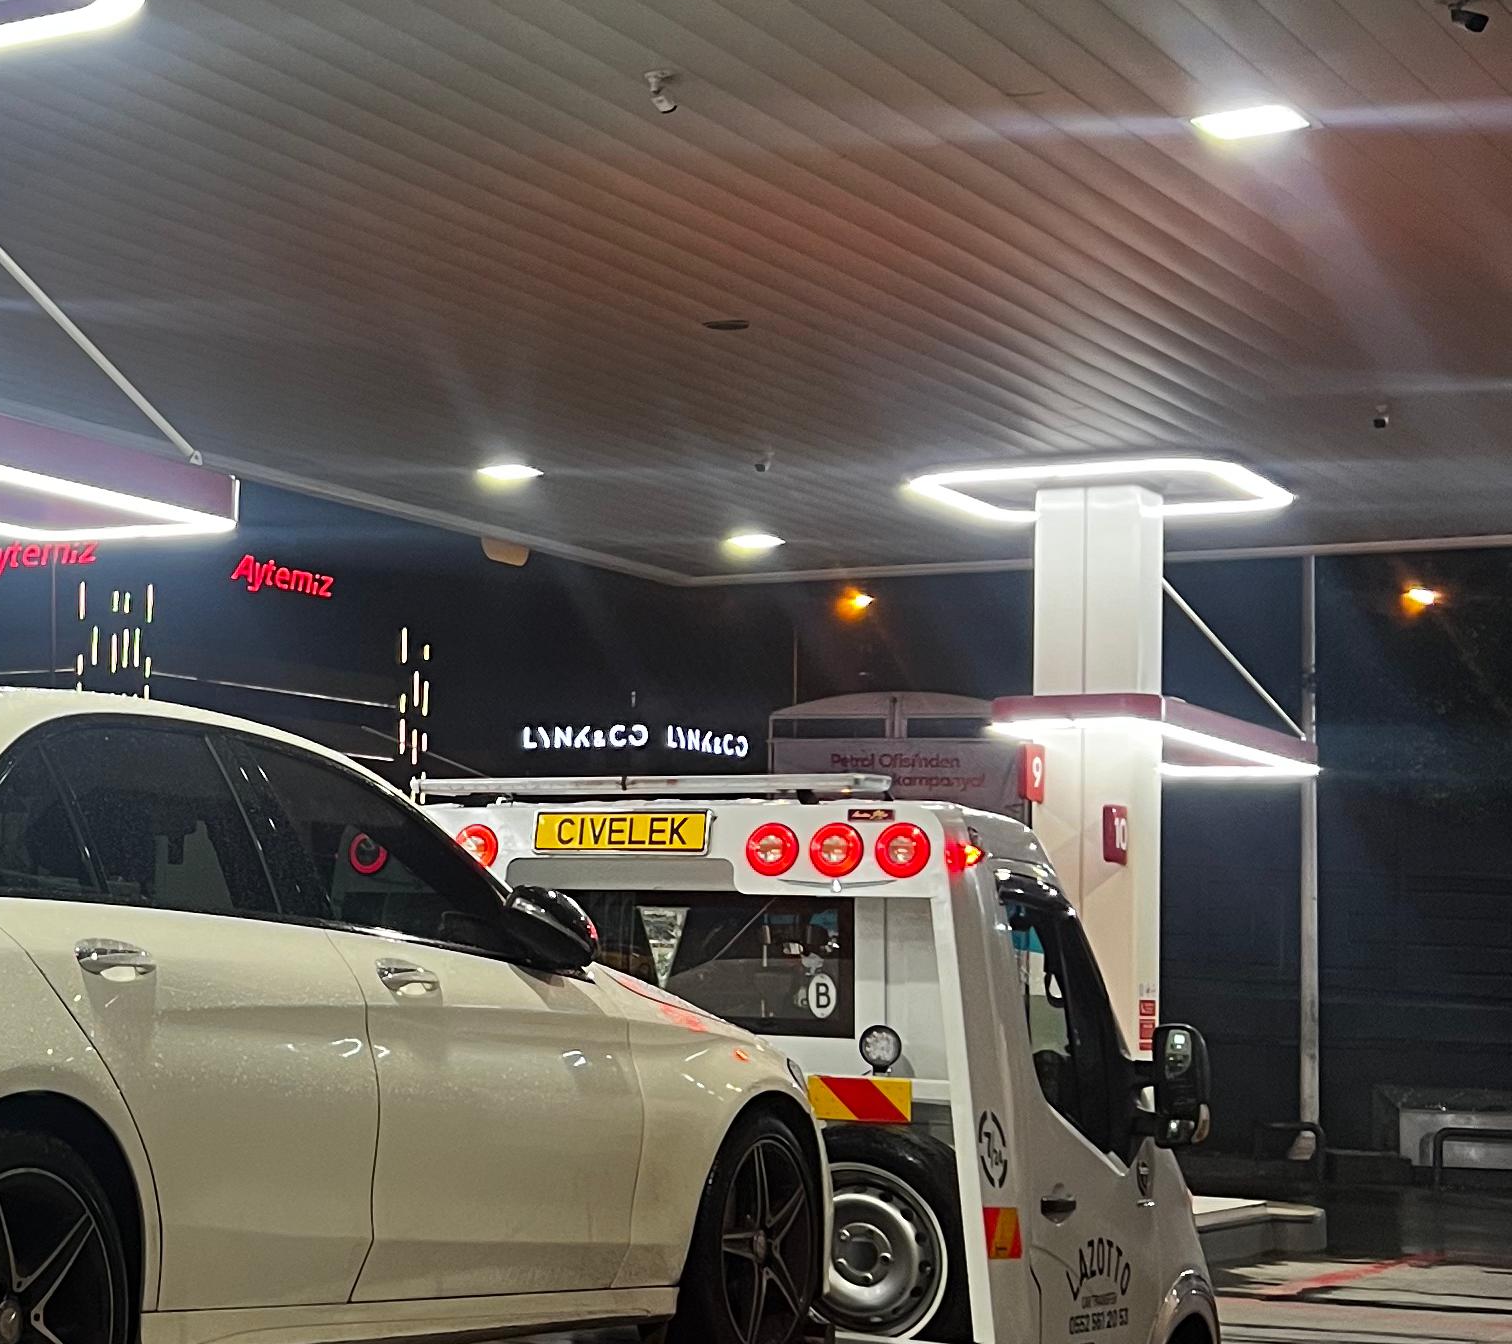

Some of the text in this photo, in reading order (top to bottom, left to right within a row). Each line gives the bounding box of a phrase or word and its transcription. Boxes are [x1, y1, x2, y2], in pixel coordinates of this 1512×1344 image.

[230, 554, 334, 598] Aytemiz
[1031, 756, 1043, 788] 9
[557, 817, 689, 845] CIVELEK
[1114, 817, 1128, 851] 10
[815, 982, 831, 1008] B
[1065, 1237, 1131, 1302] LAZOTTO
